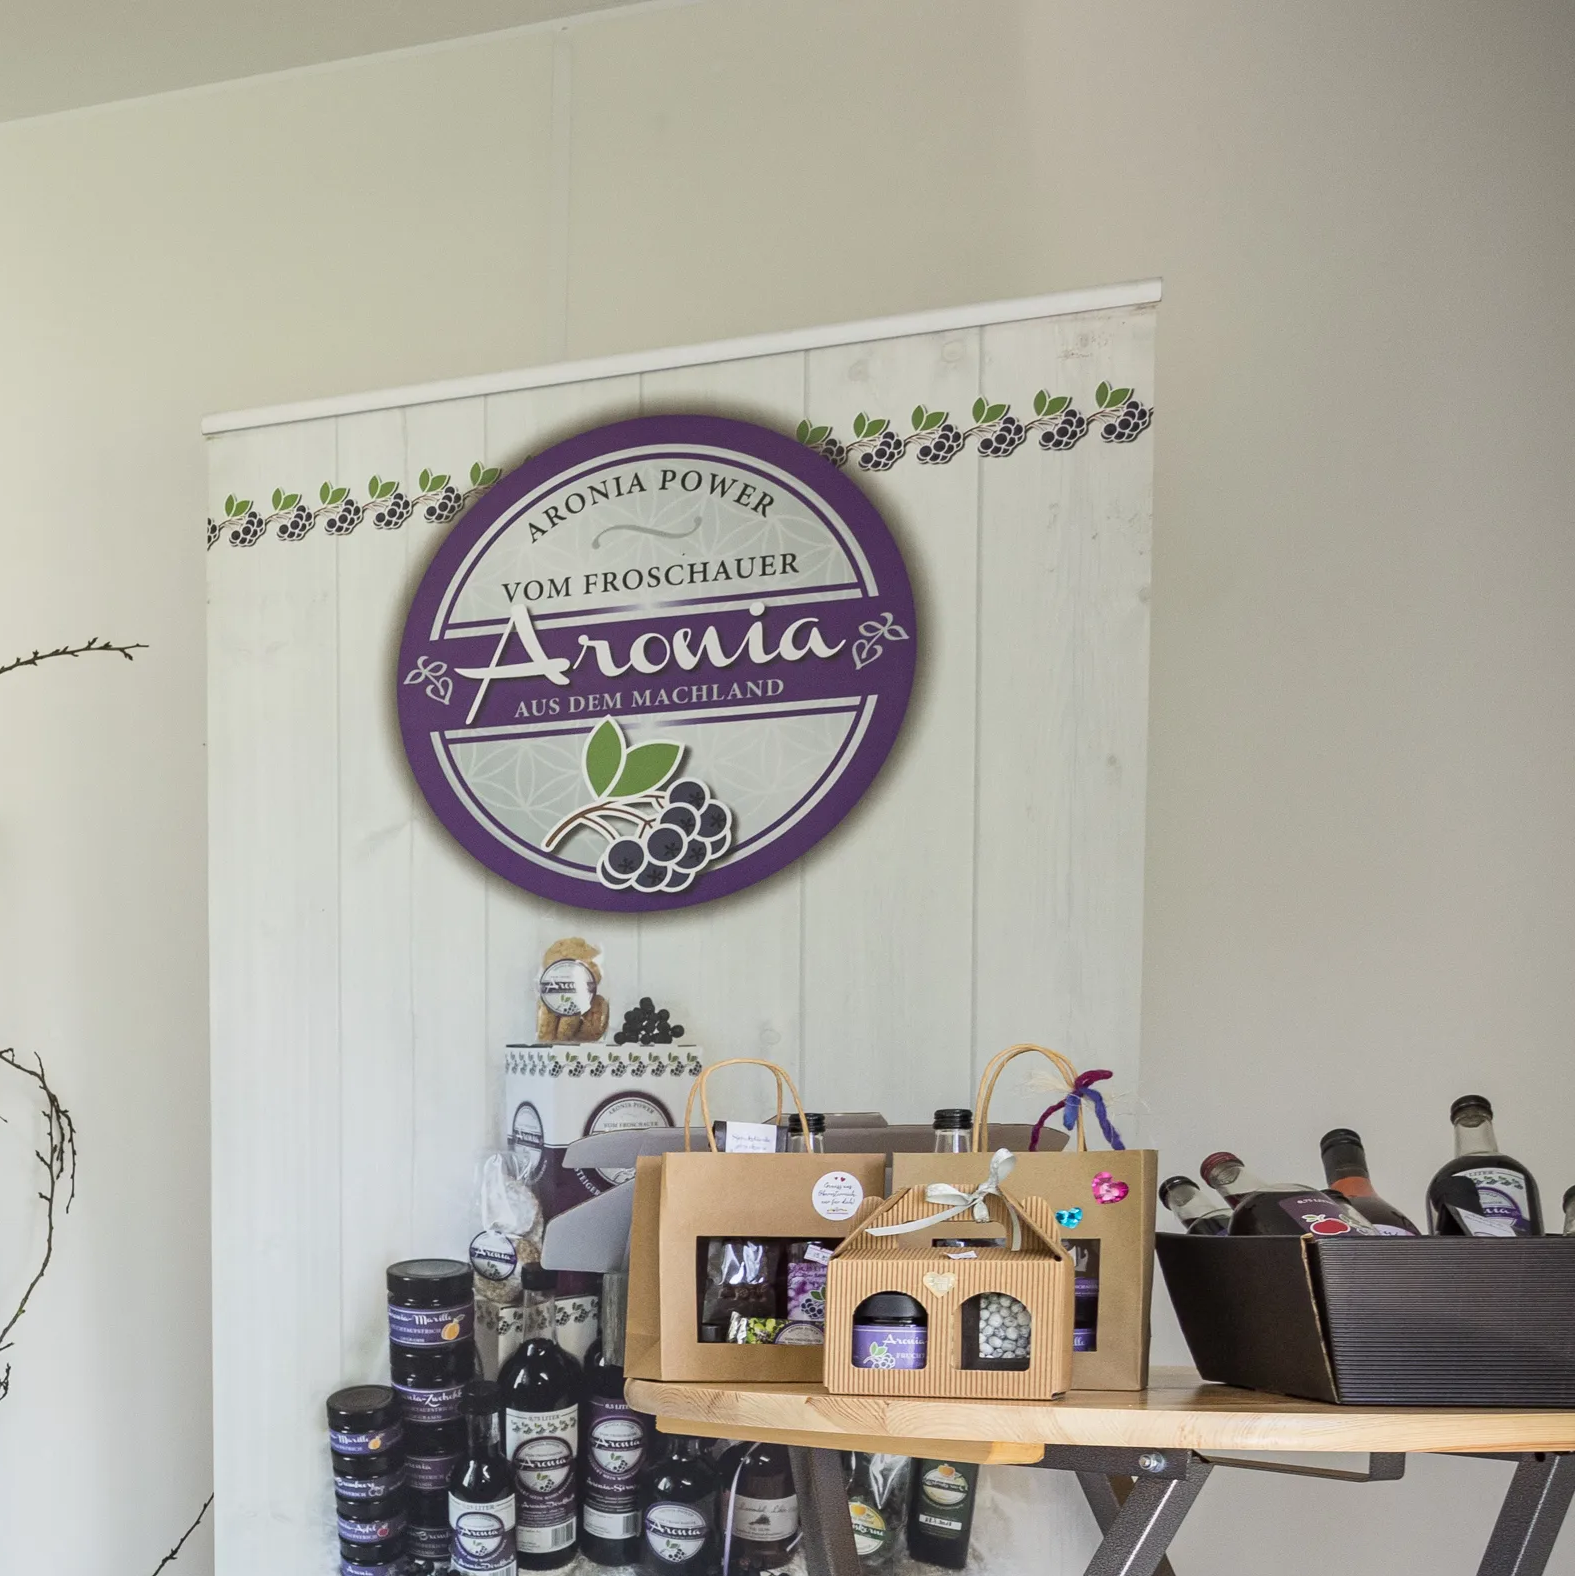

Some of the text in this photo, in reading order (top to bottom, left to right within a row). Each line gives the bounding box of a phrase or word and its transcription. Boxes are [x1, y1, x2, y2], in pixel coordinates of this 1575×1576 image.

[525, 469, 777, 544] ARONIA POWER
[502, 552, 801, 604] VOM FROSCHAUER
[453, 602, 847, 725] Aronia
[514, 677, 785, 719] AUS DEM MACHLAND
[633, 1102, 655, 1114] POWER
[593, 1437, 641, 1448] Aronia
[520, 1456, 567, 1470] Aronia
[461, 1527, 499, 1538] Aronia
[647, 1519, 703, 1537] Aronia
